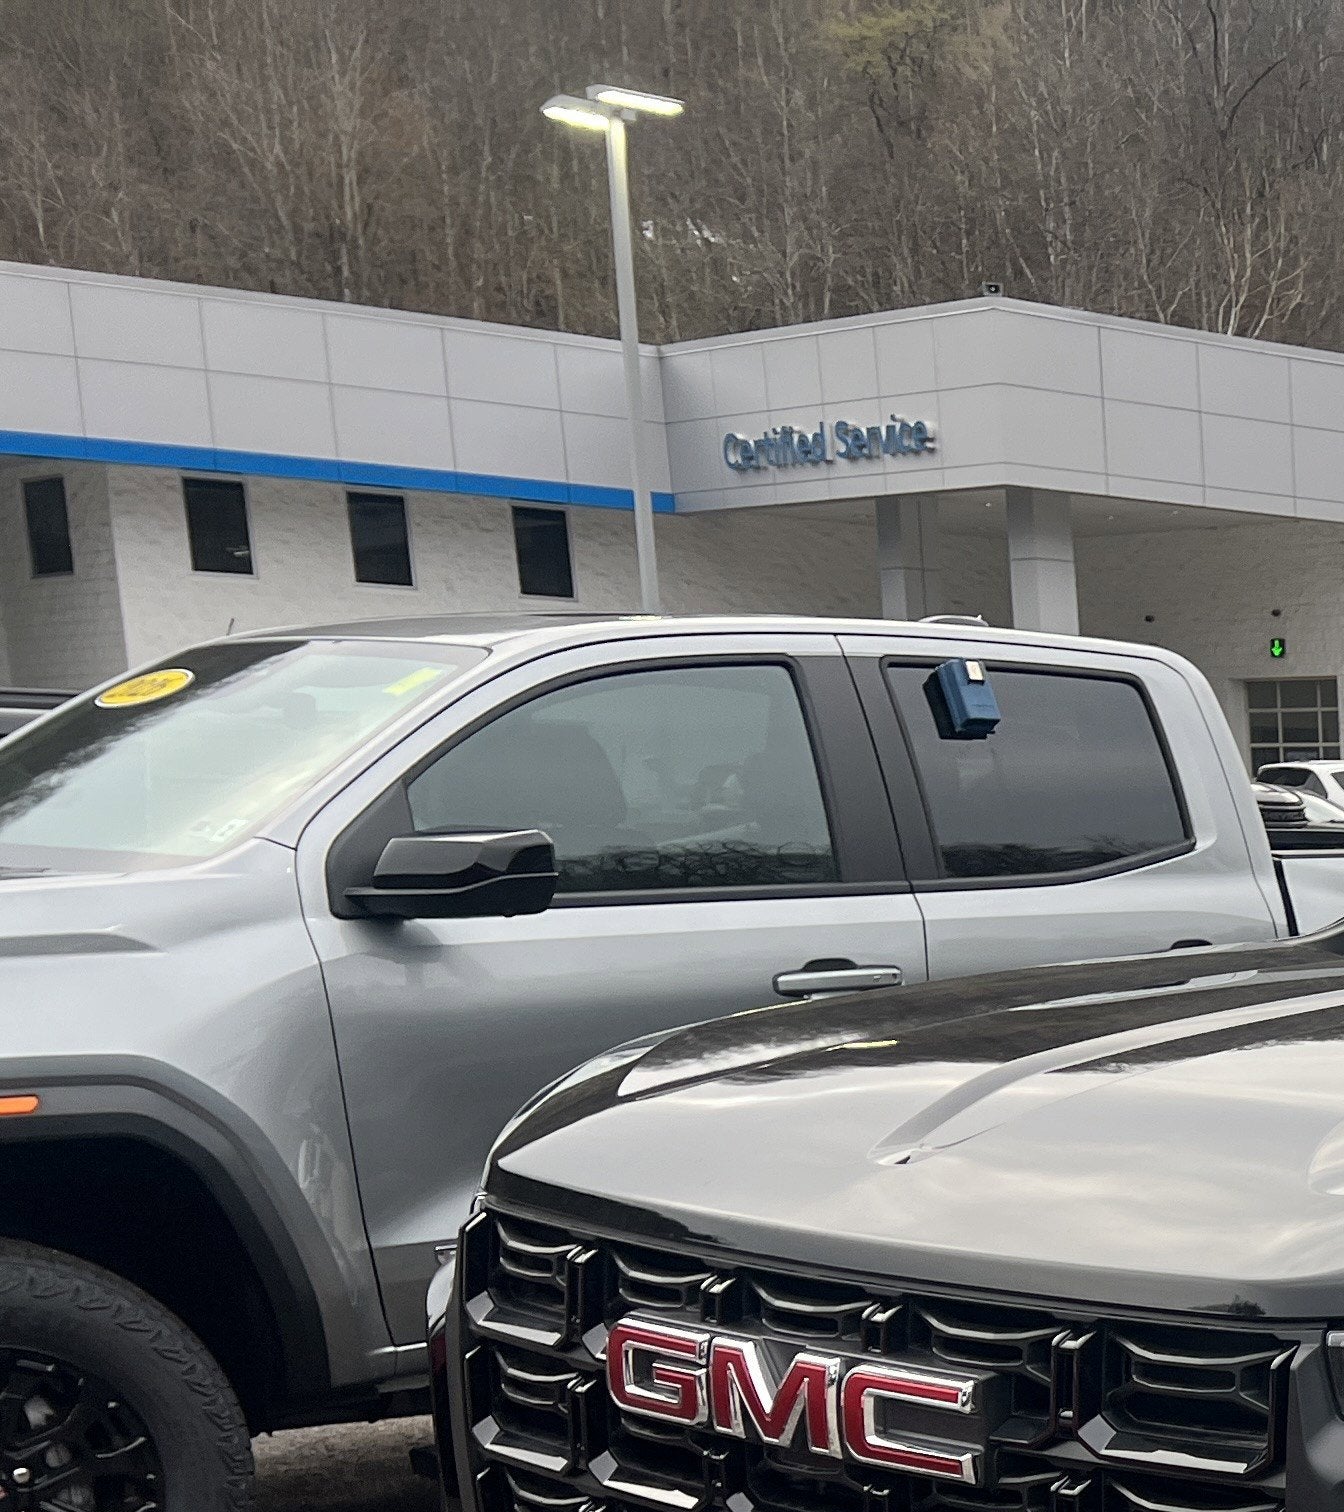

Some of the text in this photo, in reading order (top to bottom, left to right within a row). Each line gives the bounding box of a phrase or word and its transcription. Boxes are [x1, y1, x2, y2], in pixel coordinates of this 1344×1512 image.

[724, 413, 936, 471] Certified Service
[607, 1318, 976, 1485] GMC
